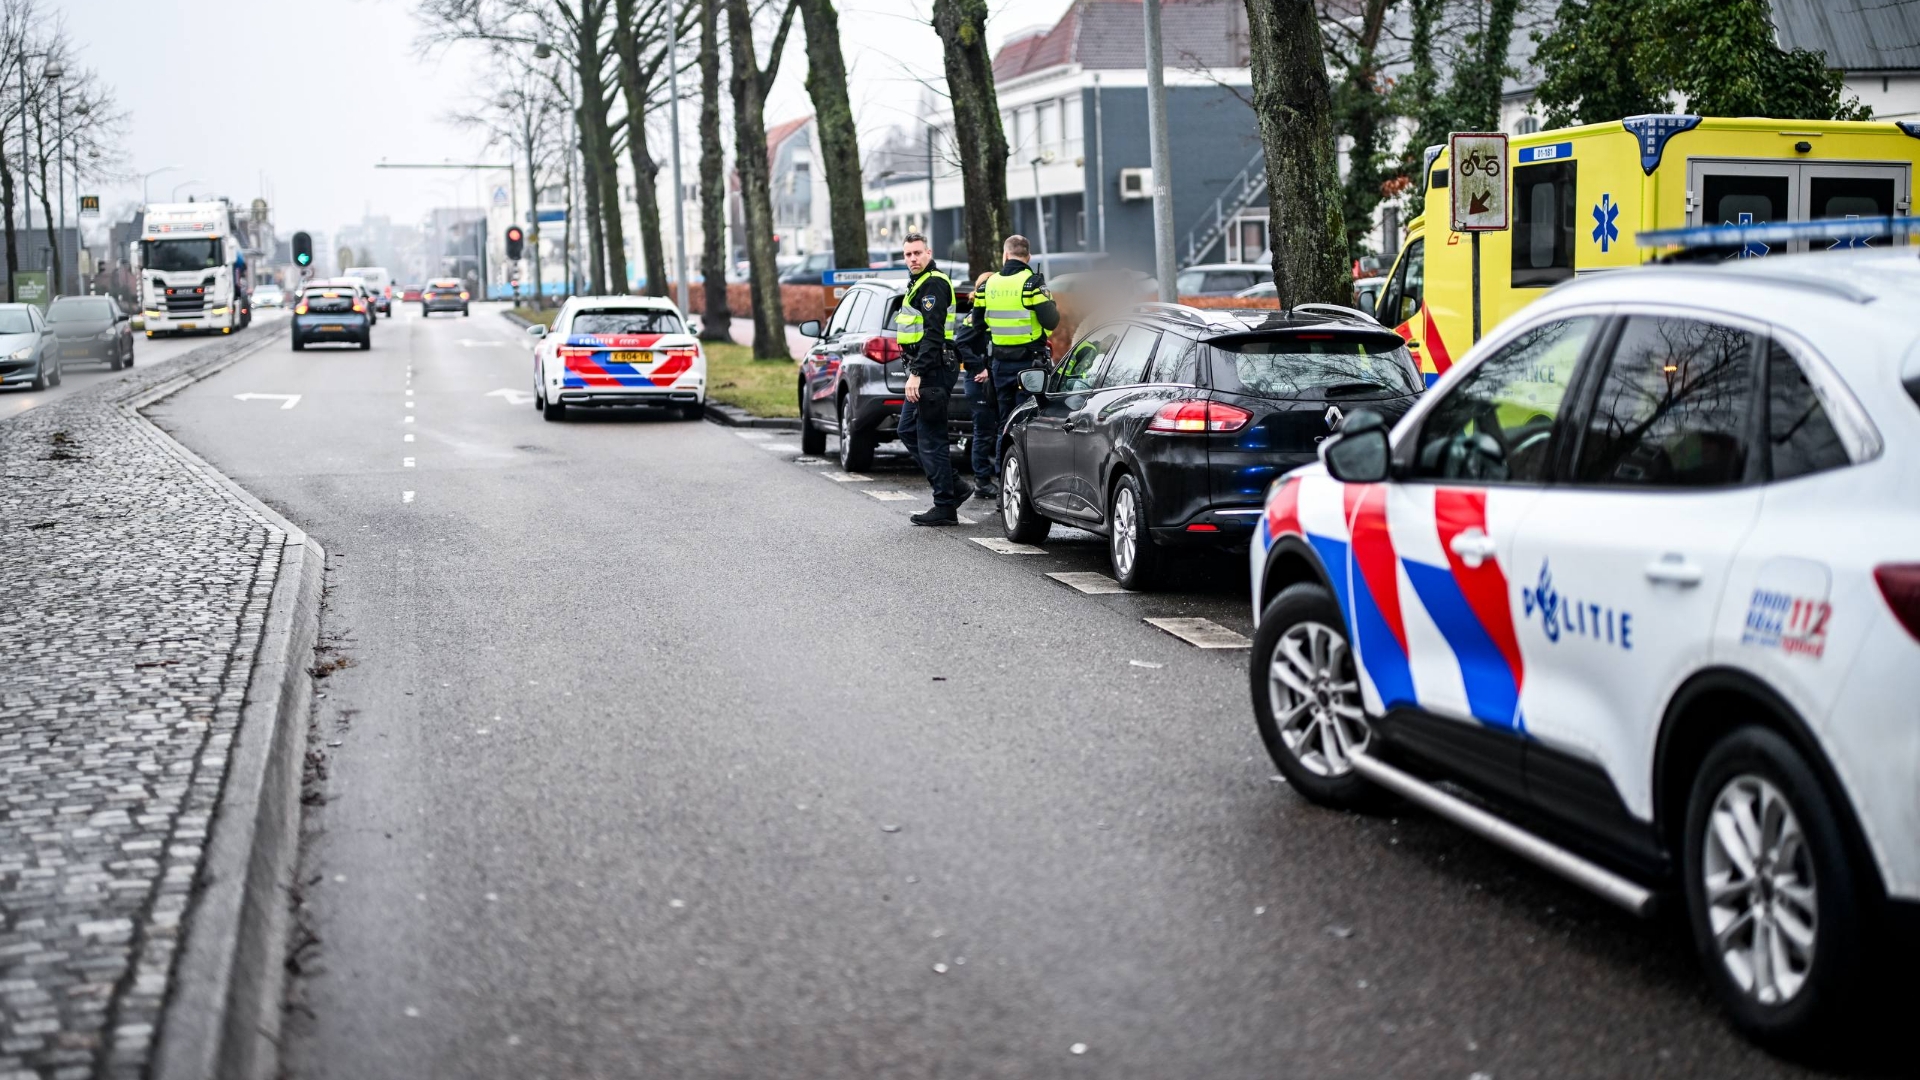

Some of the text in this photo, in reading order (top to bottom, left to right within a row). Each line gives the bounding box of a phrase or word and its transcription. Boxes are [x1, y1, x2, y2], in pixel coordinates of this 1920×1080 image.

[1537, 147, 1554, 158] 01-181
[579, 337, 615, 345] POLITIE
[612, 352, 651, 361] X-804-TR
[1522, 555, 1633, 651] POLITIE
[1789, 597, 1833, 637] 112
